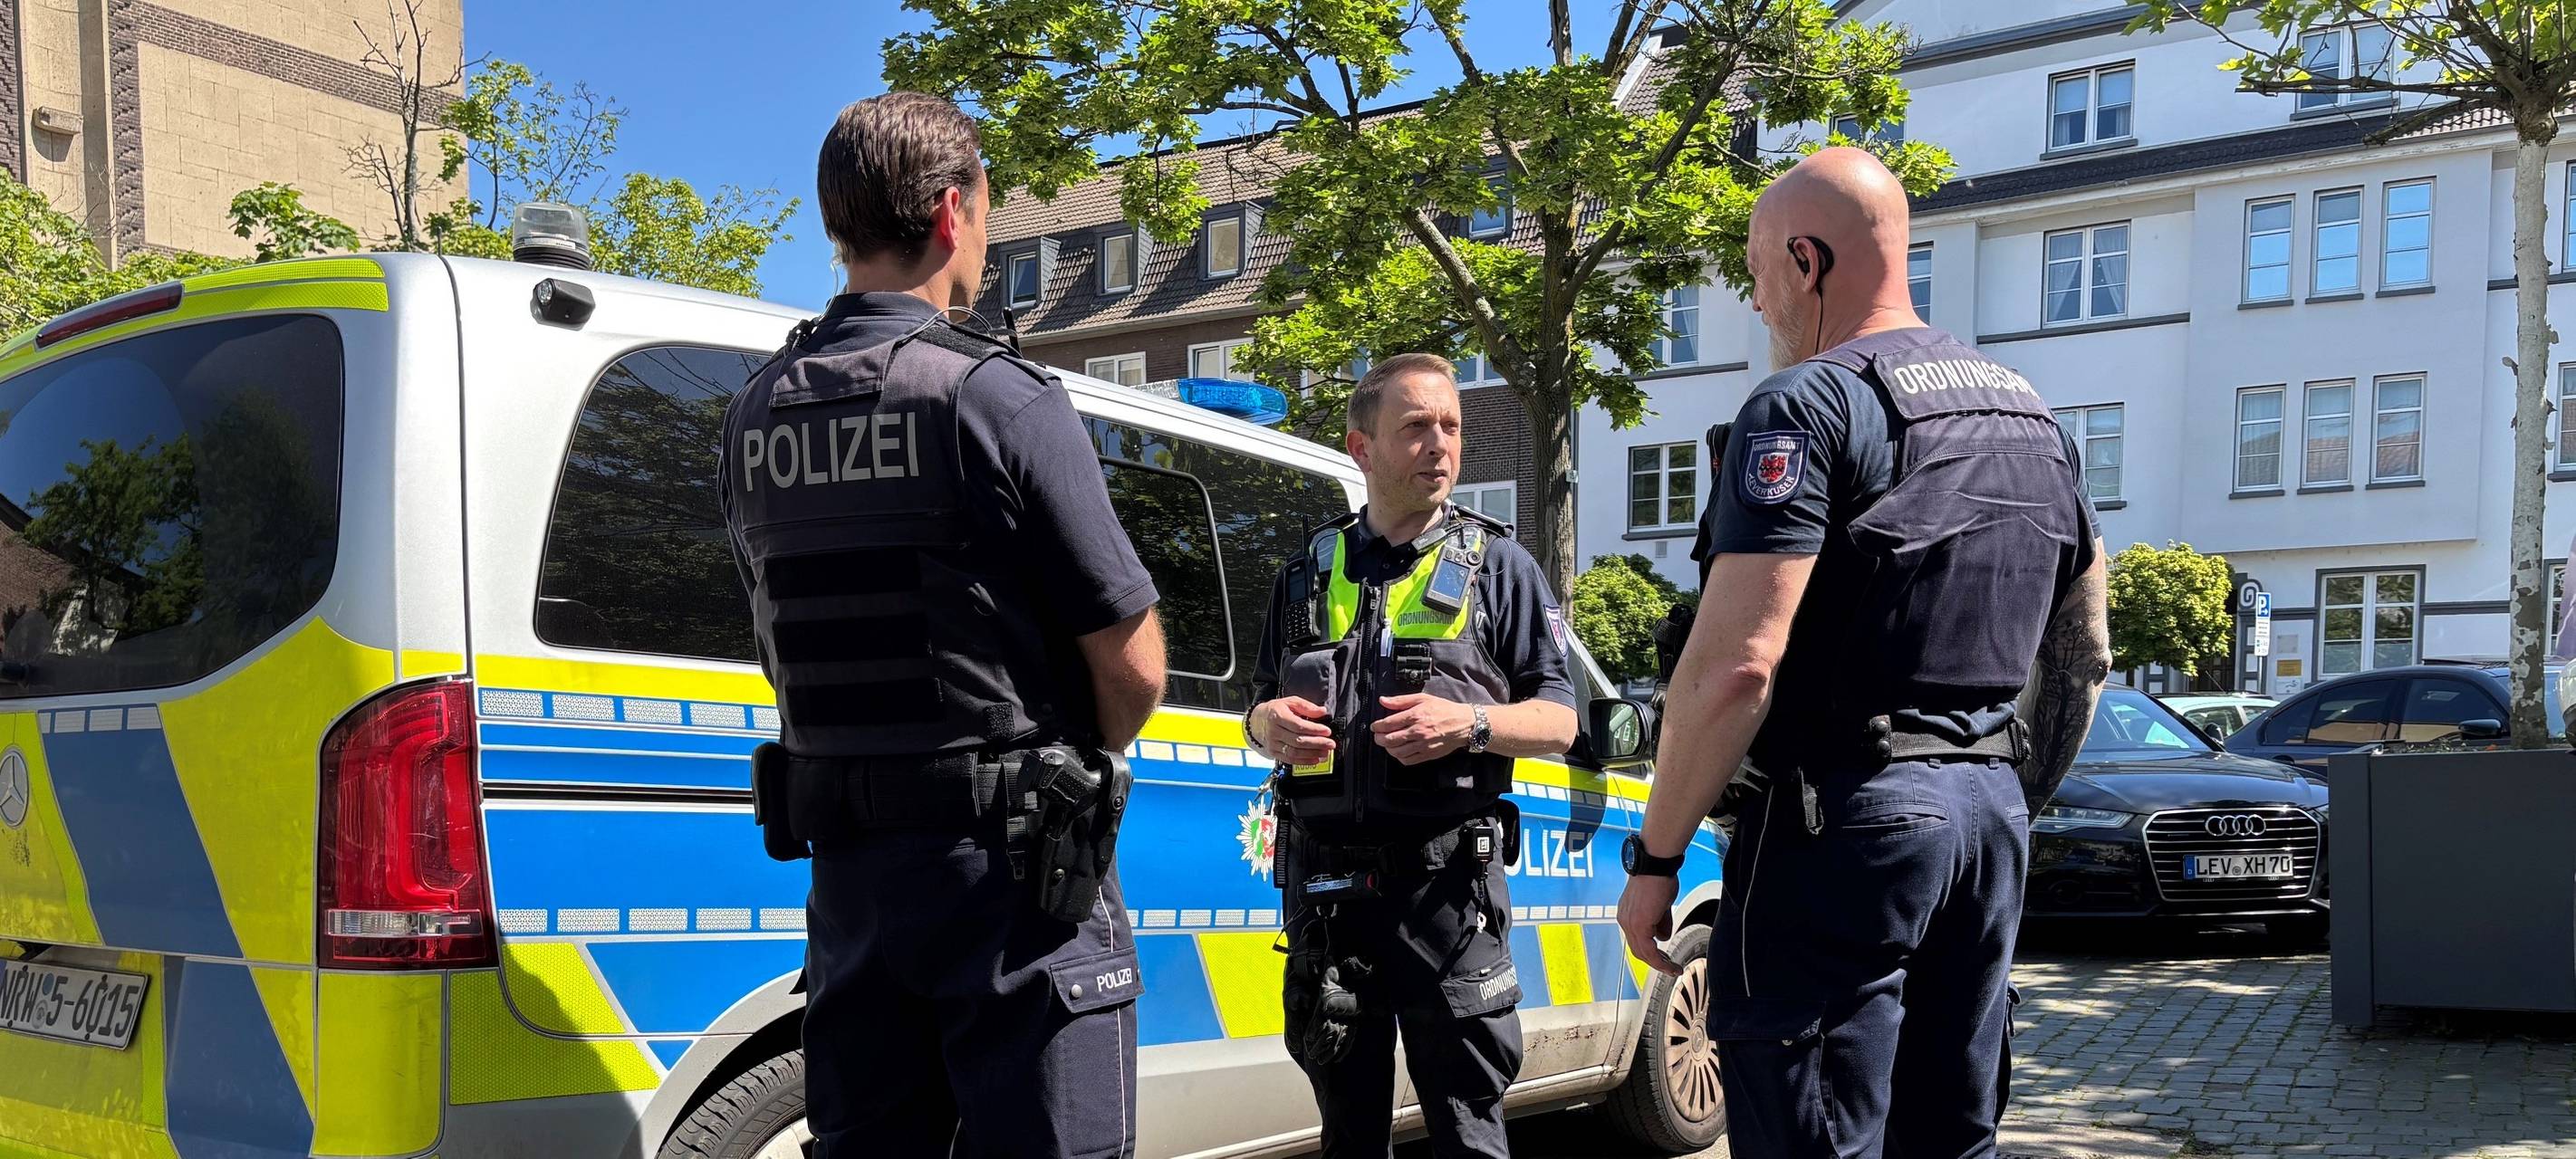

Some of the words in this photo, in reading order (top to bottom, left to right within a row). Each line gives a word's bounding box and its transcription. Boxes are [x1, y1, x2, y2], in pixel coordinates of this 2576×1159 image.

[744, 412, 919, 492] POLIZEI
[1754, 440, 1801, 452] ORDNUNGSAMT
[1748, 473, 1795, 496] LEVERKUSEN
[2258, 596, 2267, 616] P
[1503, 829, 1594, 877] LIZEI
[2196, 857, 2232, 876] LEV
[45, 975, 140, 1038] 5-6015
